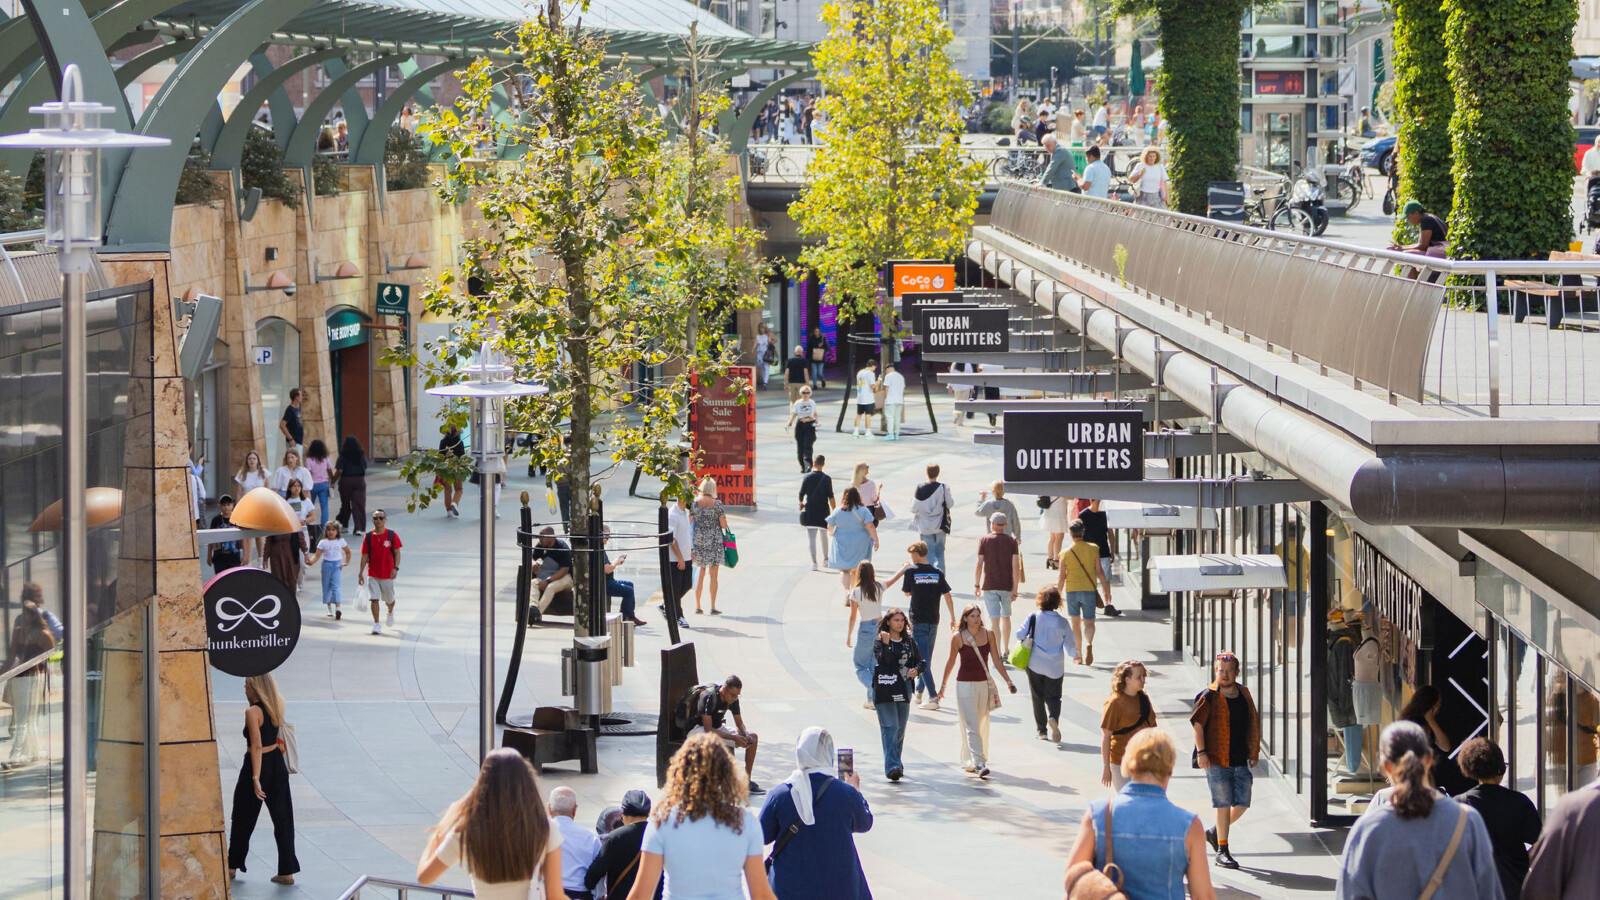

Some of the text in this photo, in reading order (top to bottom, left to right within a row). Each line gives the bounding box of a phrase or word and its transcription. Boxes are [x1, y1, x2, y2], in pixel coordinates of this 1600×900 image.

[1260, 85, 1277, 93] LIFT
[929, 316, 970, 330] URBAN
[331, 323, 360, 341] THE BODY SHOP
[930, 332, 1002, 346] OUTFITTERS
[263, 350, 271, 363] P
[702, 398, 740, 407] Summe
[712, 407, 733, 416] Sale
[1067, 422, 1131, 443] URBAN
[1016, 448, 1131, 470] OUTFITTERS
[1353, 533, 1422, 650] URBAN OUTFITTERS
[207, 633, 291, 650] hunkemöller
